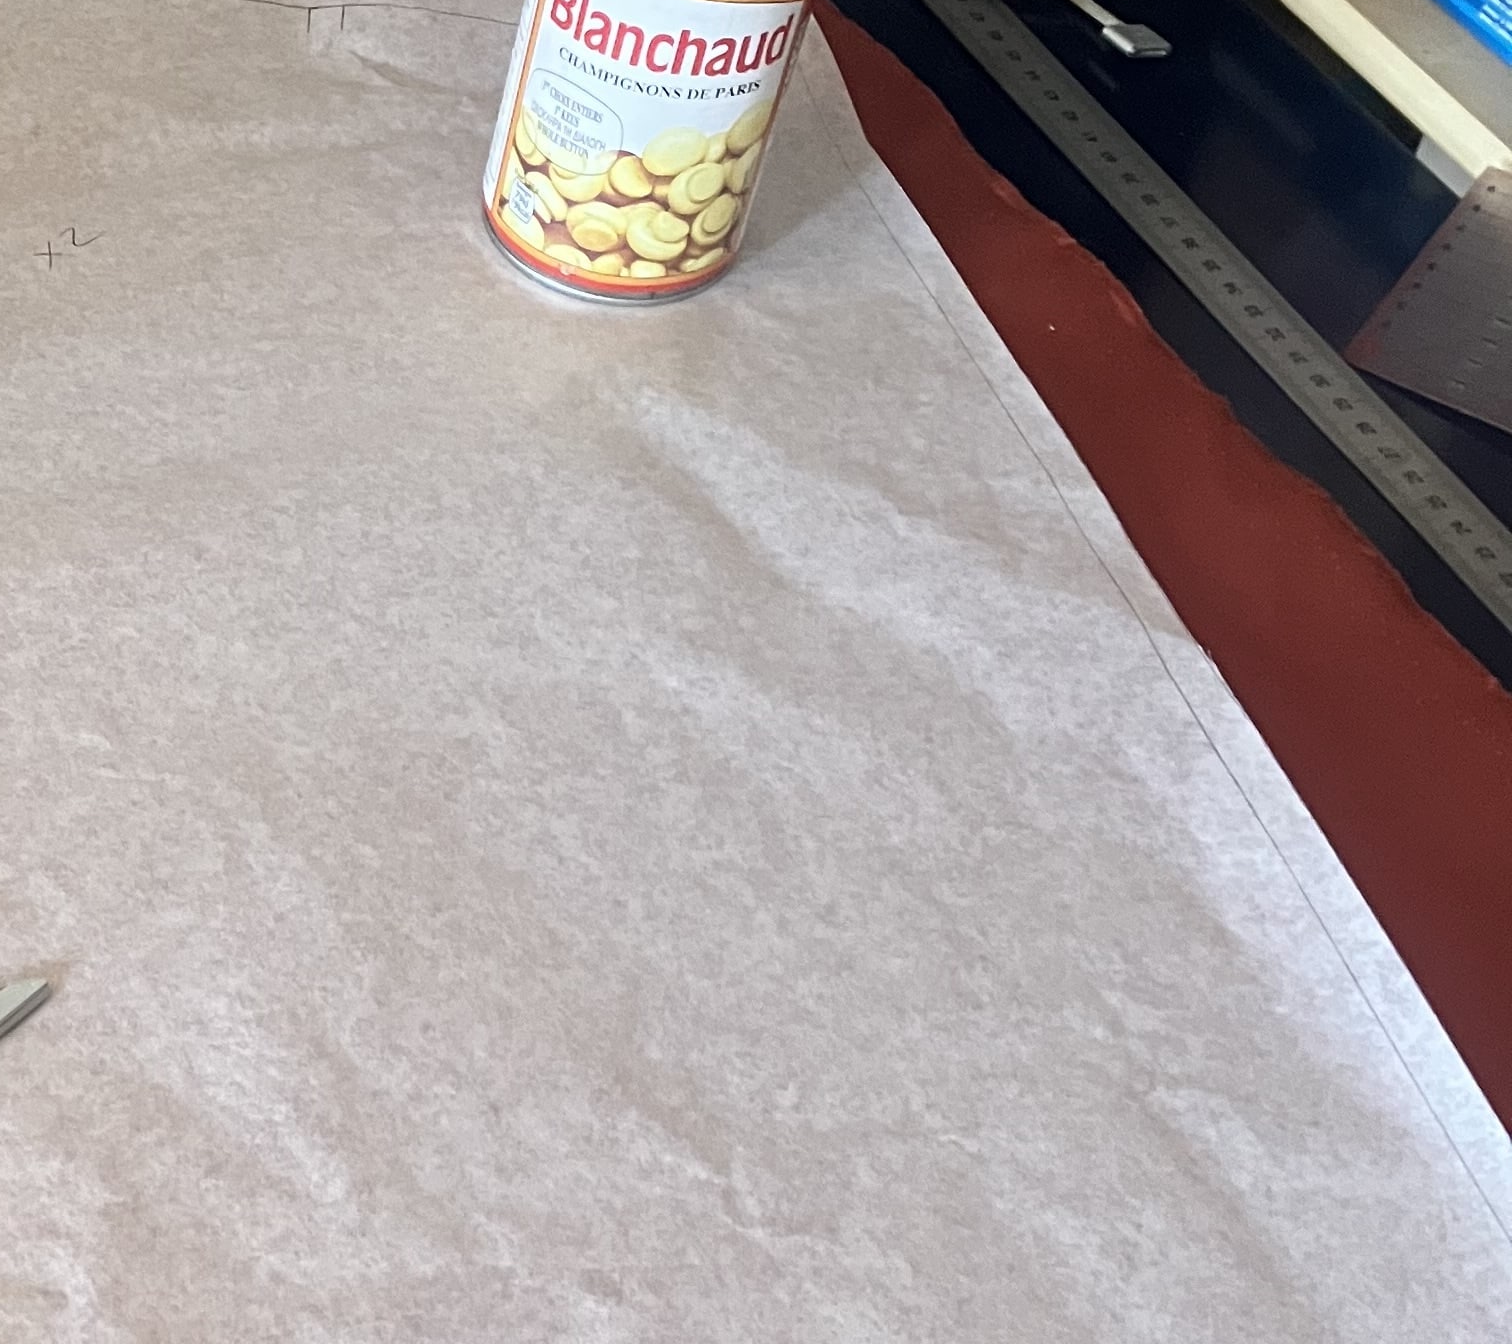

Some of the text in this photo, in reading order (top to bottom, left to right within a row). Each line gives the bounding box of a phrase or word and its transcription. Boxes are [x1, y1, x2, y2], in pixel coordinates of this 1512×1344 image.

[559, 47, 761, 100] CHAMPIGNONS DE PARIS
